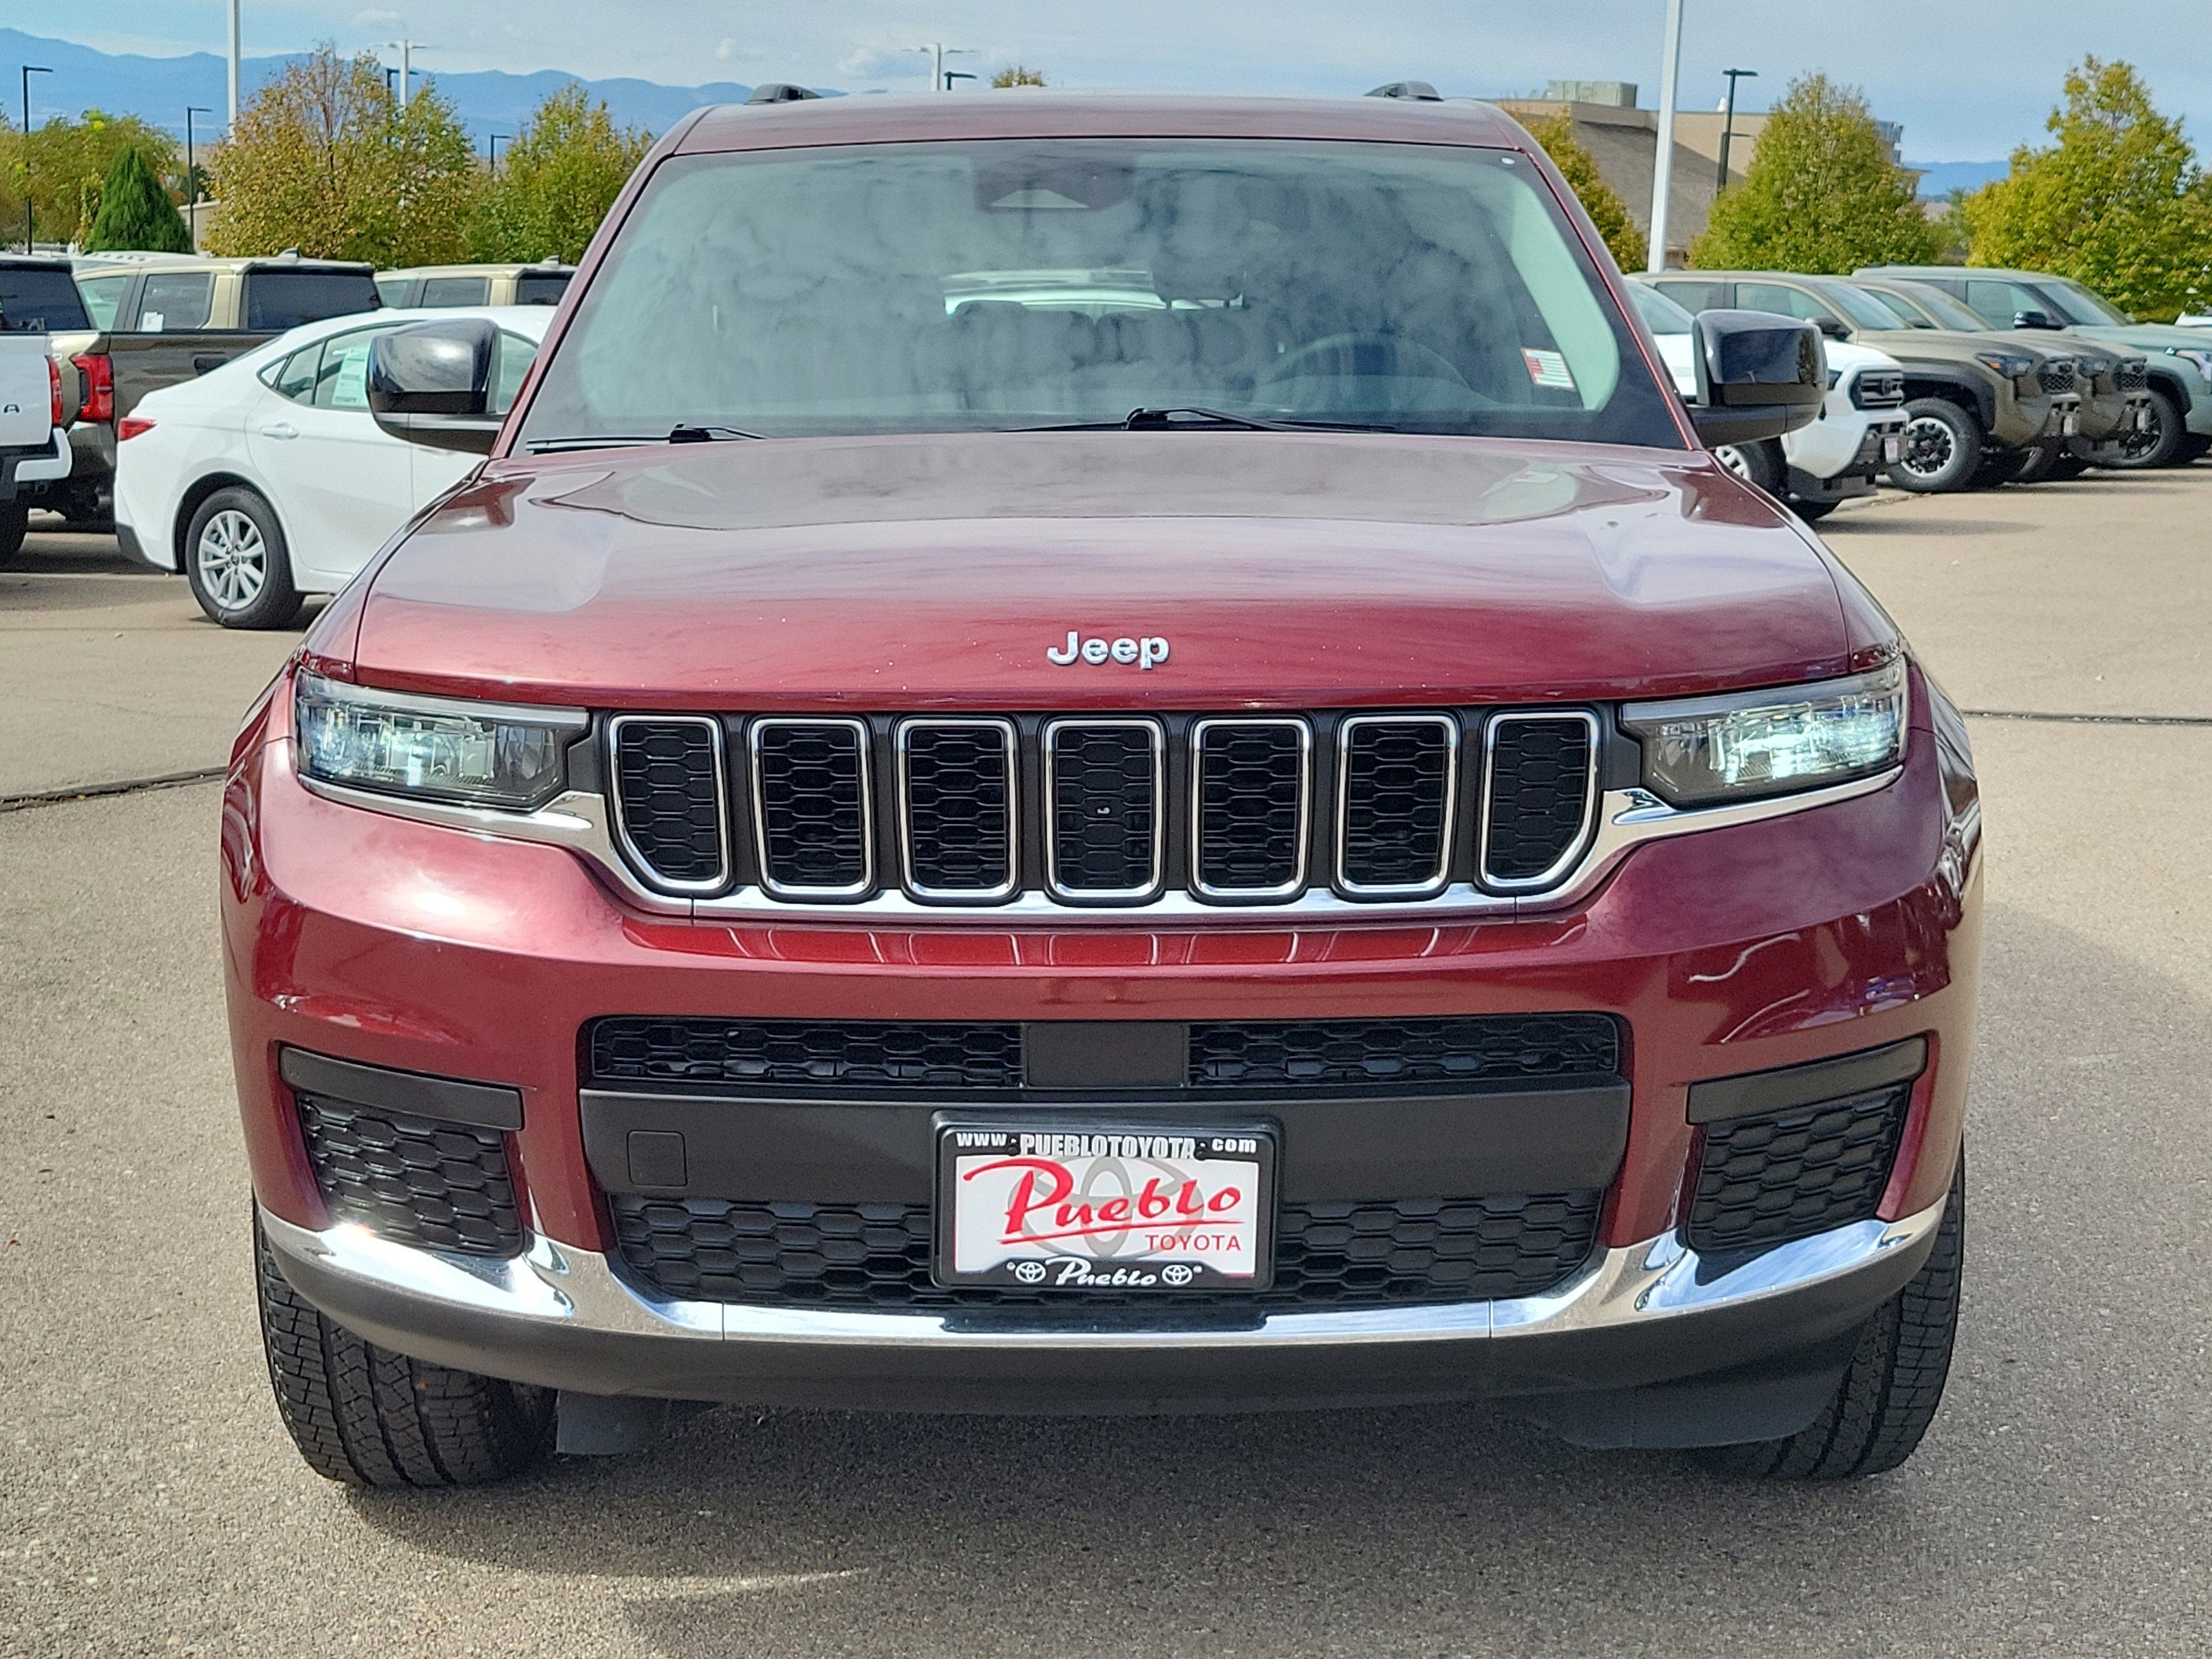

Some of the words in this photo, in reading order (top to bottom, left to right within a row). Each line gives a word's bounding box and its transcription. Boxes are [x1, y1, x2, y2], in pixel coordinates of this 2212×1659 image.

[1047, 630, 1170, 670] Jeep
[963, 1158, 1241, 1234] Pueblo
[1145, 1234, 1241, 1251] TOYOTA
[1045, 1257, 1157, 1286] Pueblo
